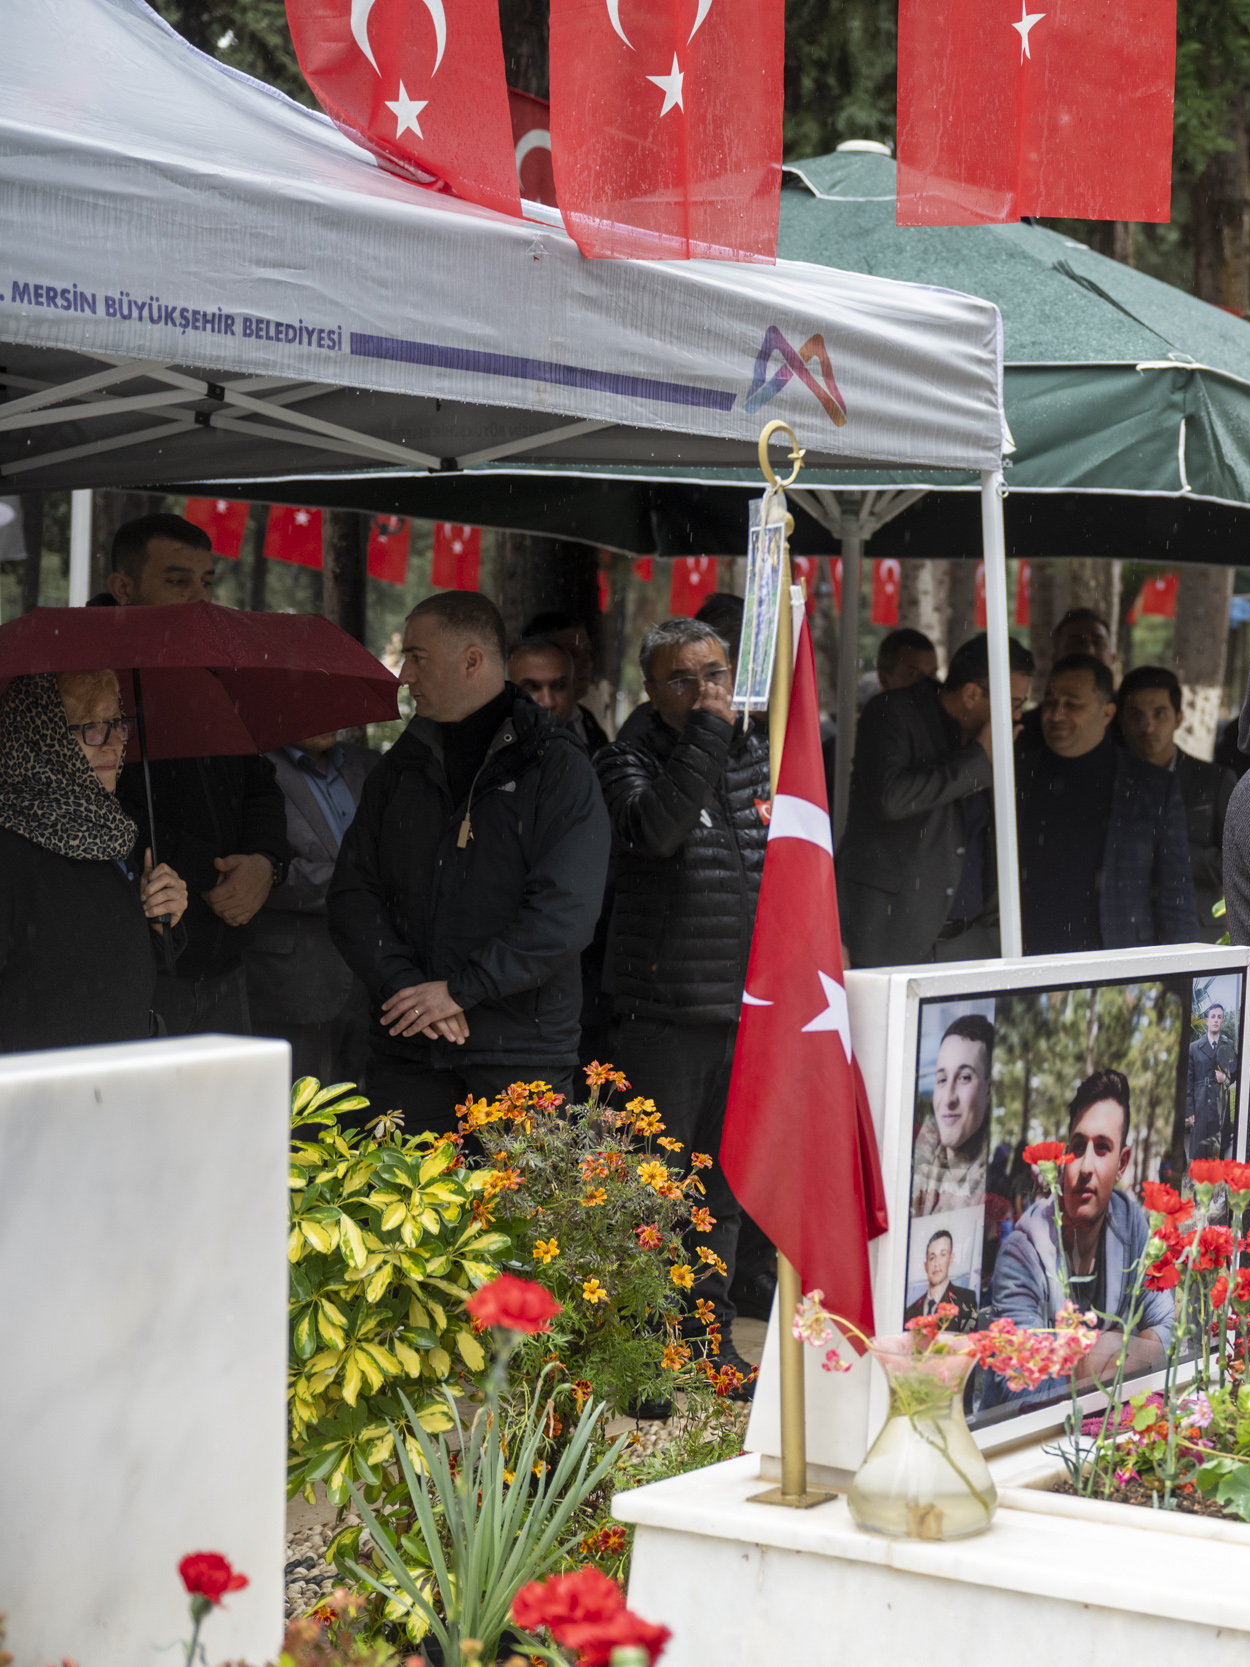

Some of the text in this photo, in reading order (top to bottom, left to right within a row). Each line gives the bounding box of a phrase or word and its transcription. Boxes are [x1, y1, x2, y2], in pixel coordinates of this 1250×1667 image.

[11, 280, 342, 351] MERSİN BÜYÜKŞEHİR BELEDİYESİ
